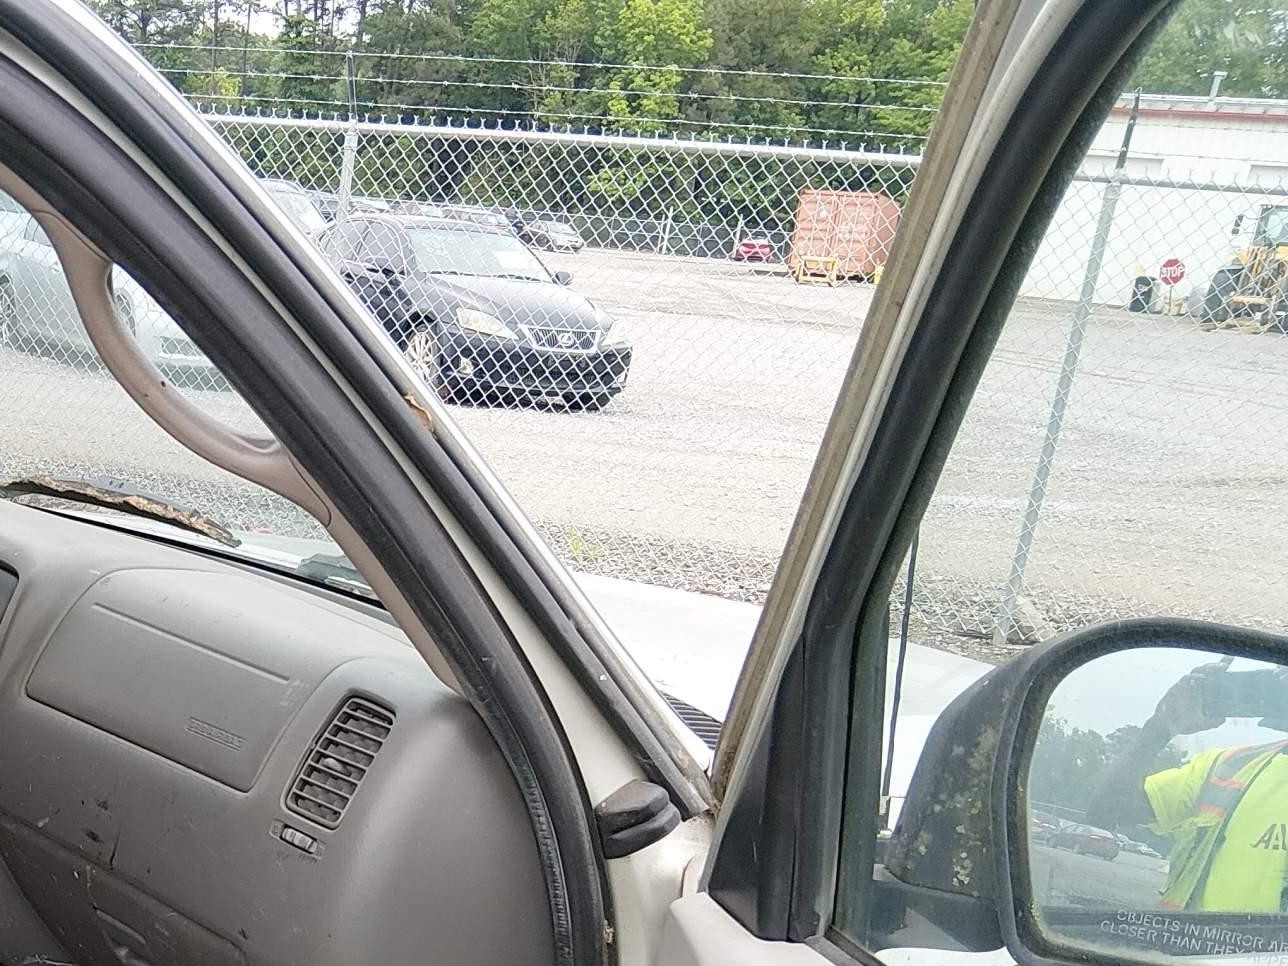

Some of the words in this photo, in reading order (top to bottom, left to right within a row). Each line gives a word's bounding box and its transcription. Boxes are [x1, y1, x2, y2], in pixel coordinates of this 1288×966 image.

[1161, 265, 1185, 278] STOP
[1100, 920, 1158, 942] CLOSER
[1162, 932, 1202, 951] THAN
[1116, 909, 1181, 932] OBJECTS
[1184, 922, 1200, 936] IN
[1203, 927, 1263, 949] MIRROR
